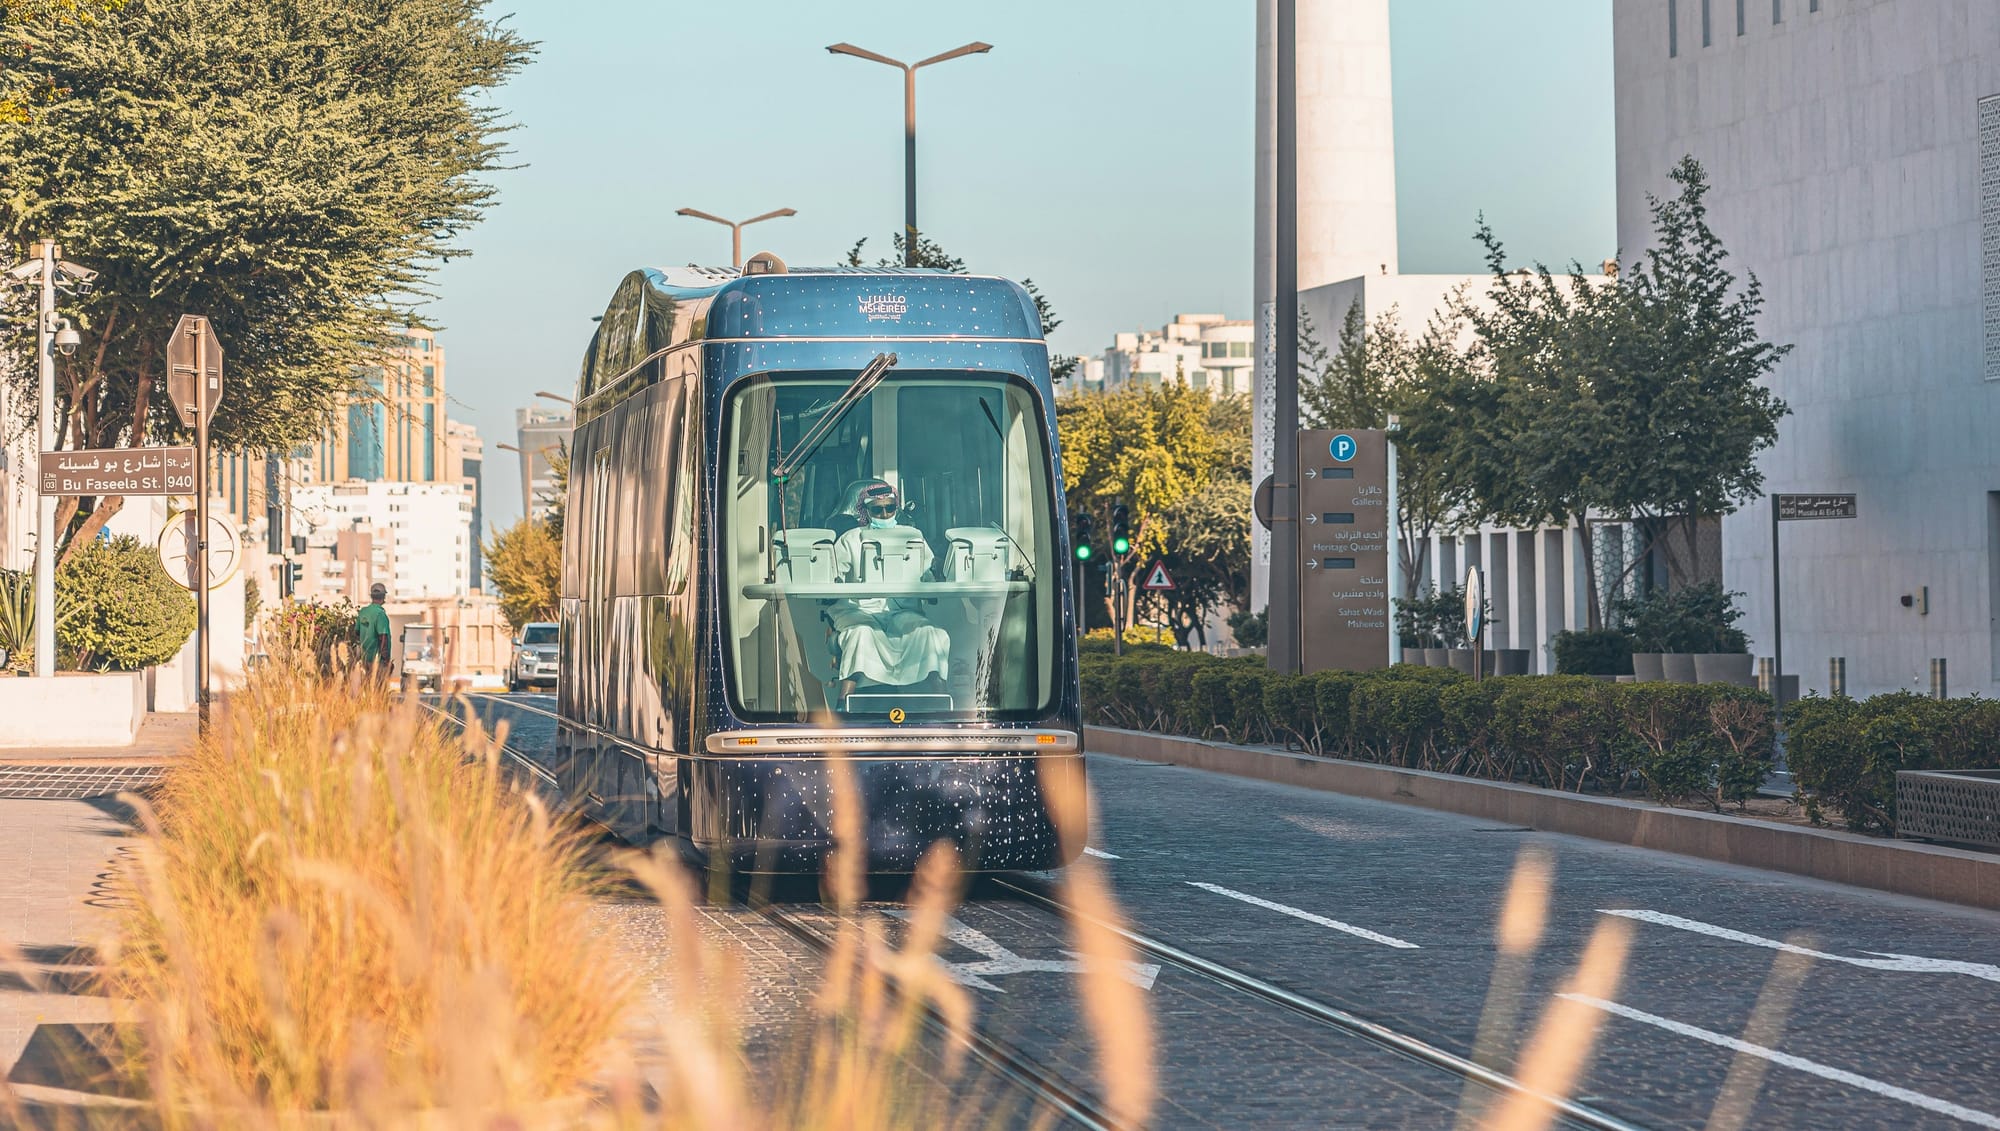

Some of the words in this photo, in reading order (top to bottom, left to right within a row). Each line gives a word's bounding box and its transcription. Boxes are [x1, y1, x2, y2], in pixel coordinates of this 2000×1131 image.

[859, 304, 907, 313] MSHEIREB
[1338, 441, 1350, 457] P
[58, 455, 100, 473] فسيلة
[104, 459, 118, 473] بو
[123, 455, 161, 473] شارع
[167, 458, 179, 467] St.
[63, 478, 81, 491] Bu
[86, 477, 138, 490] Faseela
[142, 477, 162, 489] St.
[167, 475, 193, 488] 940
[1351, 497, 1383, 506] Galleria
[1312, 543, 1348, 553] Heritage
[1349, 543, 1383, 552] Quarter
[1347, 620, 1385, 628] Msheireb
[893, 709, 902, 721] 2
